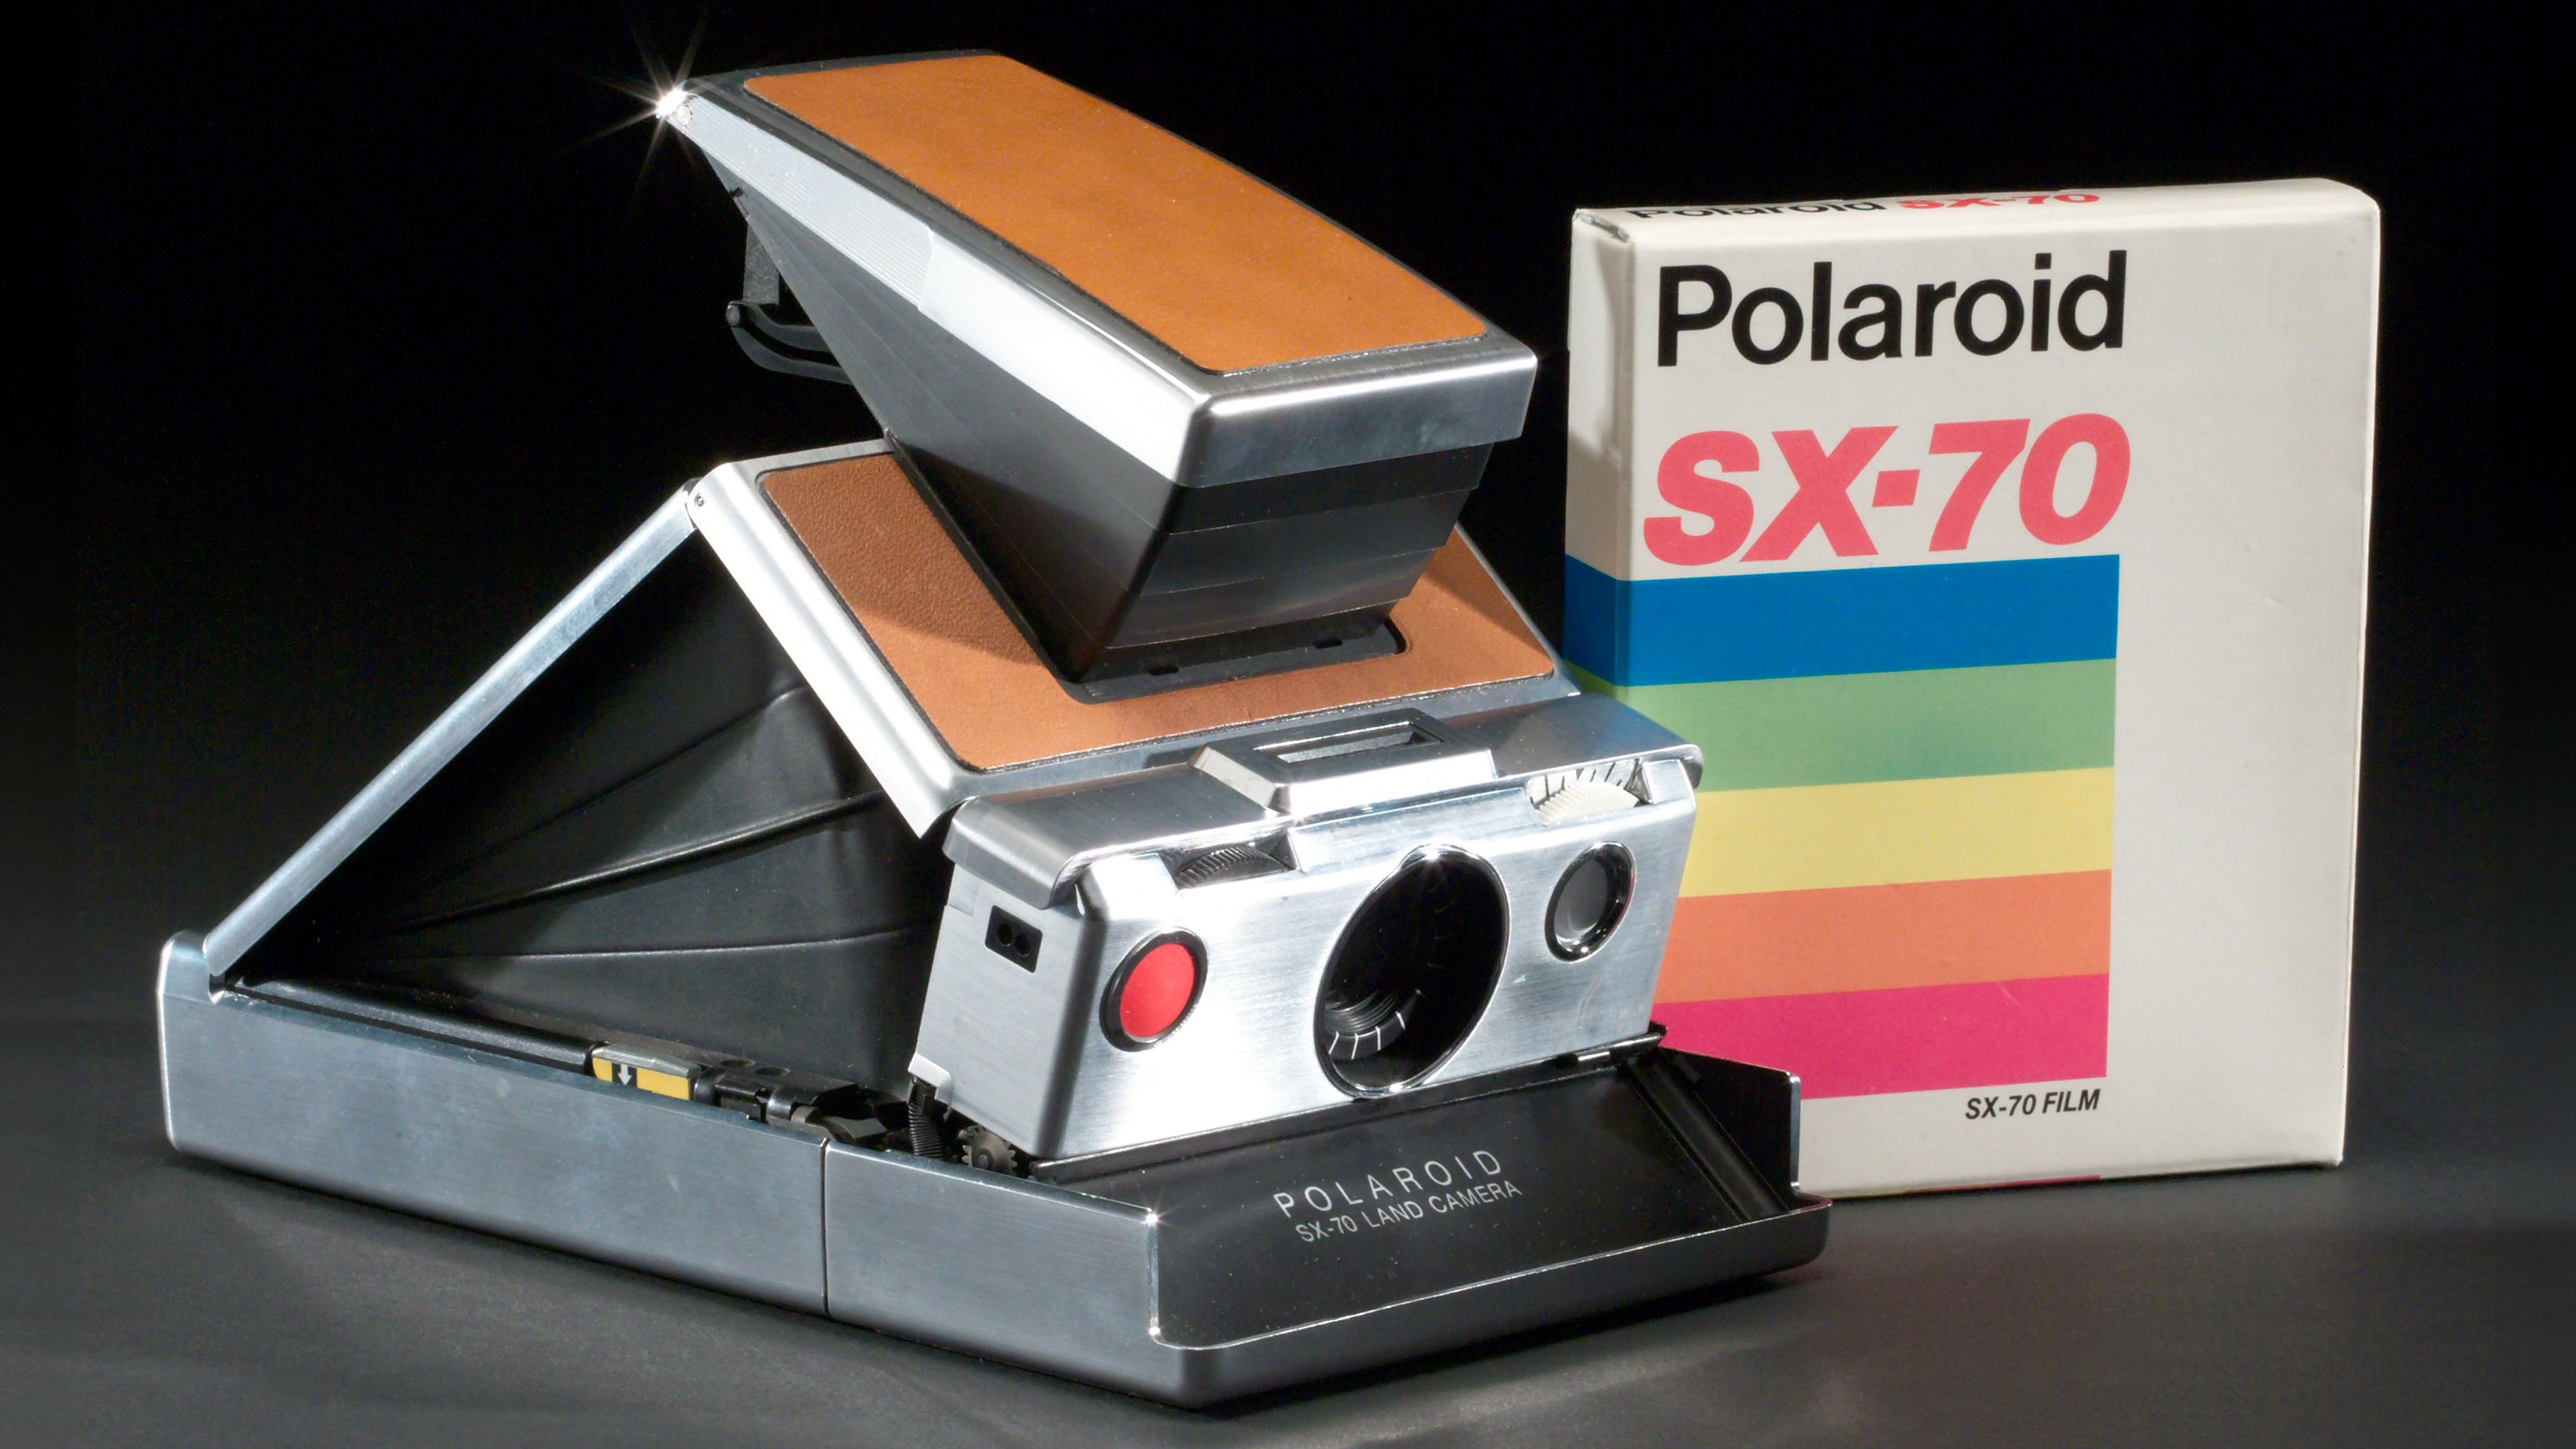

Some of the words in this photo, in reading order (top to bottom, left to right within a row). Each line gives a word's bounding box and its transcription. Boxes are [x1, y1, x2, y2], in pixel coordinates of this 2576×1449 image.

[1897, 193, 2101, 210] SX-70
[1657, 250, 2127, 367] Polaroid
[1643, 413, 2131, 566] SX-70
[1965, 1094, 2037, 1120] SX-70
[2042, 1089, 2100, 1113] FILM
[1273, 1150, 1501, 1218] POLAROID
[1295, 1215, 1358, 1242] SX-70
[1361, 1201, 1424, 1228] LAND
[1428, 1180, 1522, 1213] CAMERA
